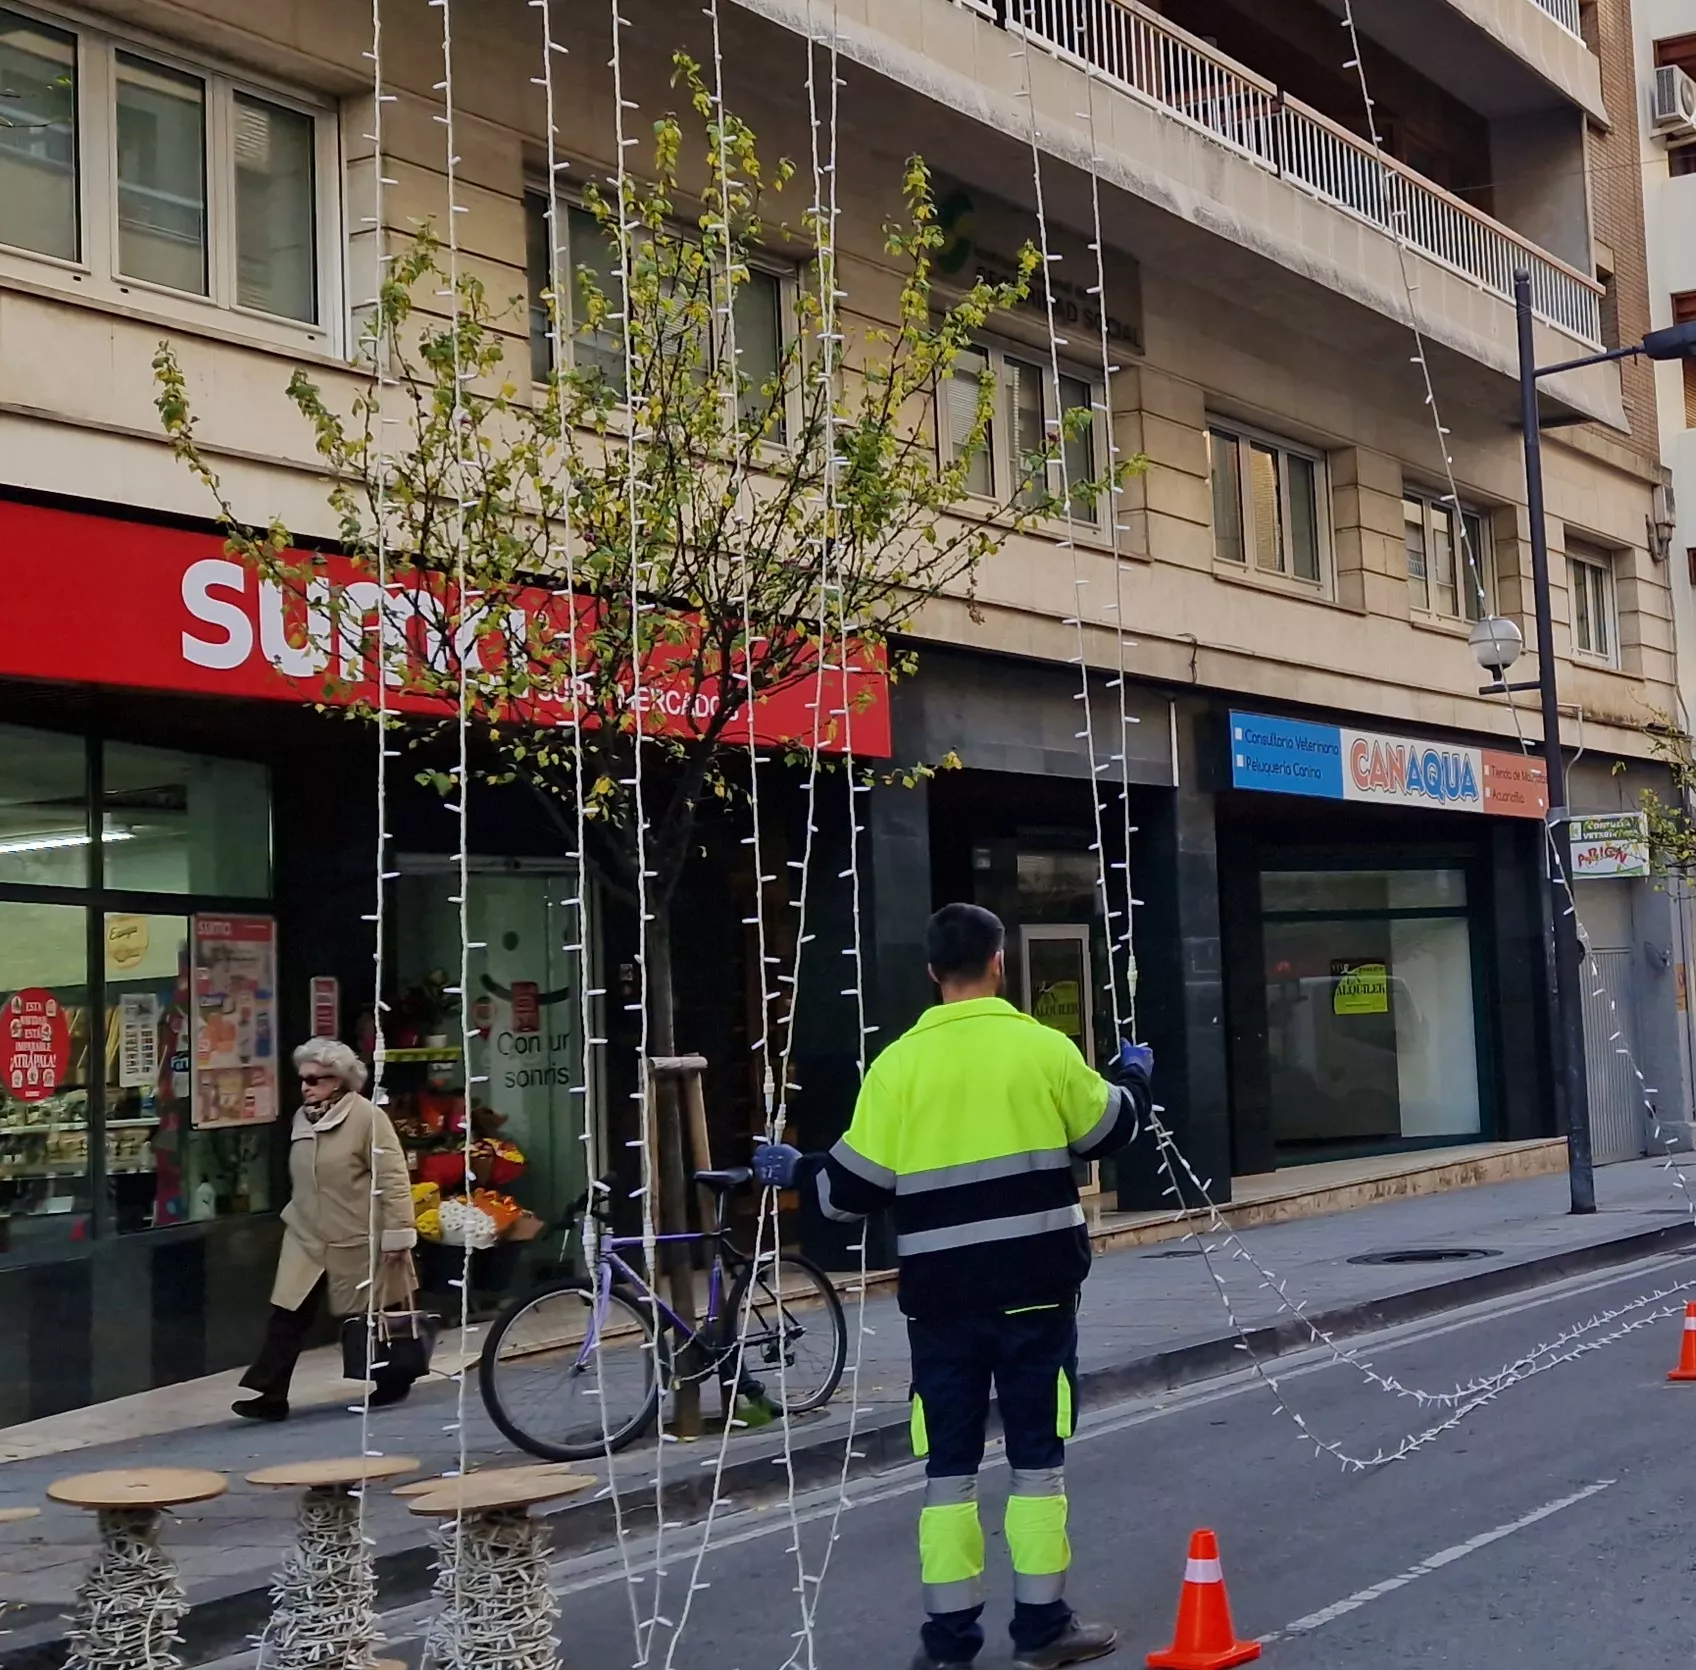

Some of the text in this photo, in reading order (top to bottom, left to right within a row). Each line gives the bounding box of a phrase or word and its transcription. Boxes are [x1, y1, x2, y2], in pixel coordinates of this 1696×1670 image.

[1244, 728, 1340, 756] Consultorio Veterinario
[1350, 738, 1480, 805] CANAQUA
[1491, 765, 1512, 780] Tienda
[497, 1031, 541, 1056] Con
[504, 1062, 571, 1089] sonris
